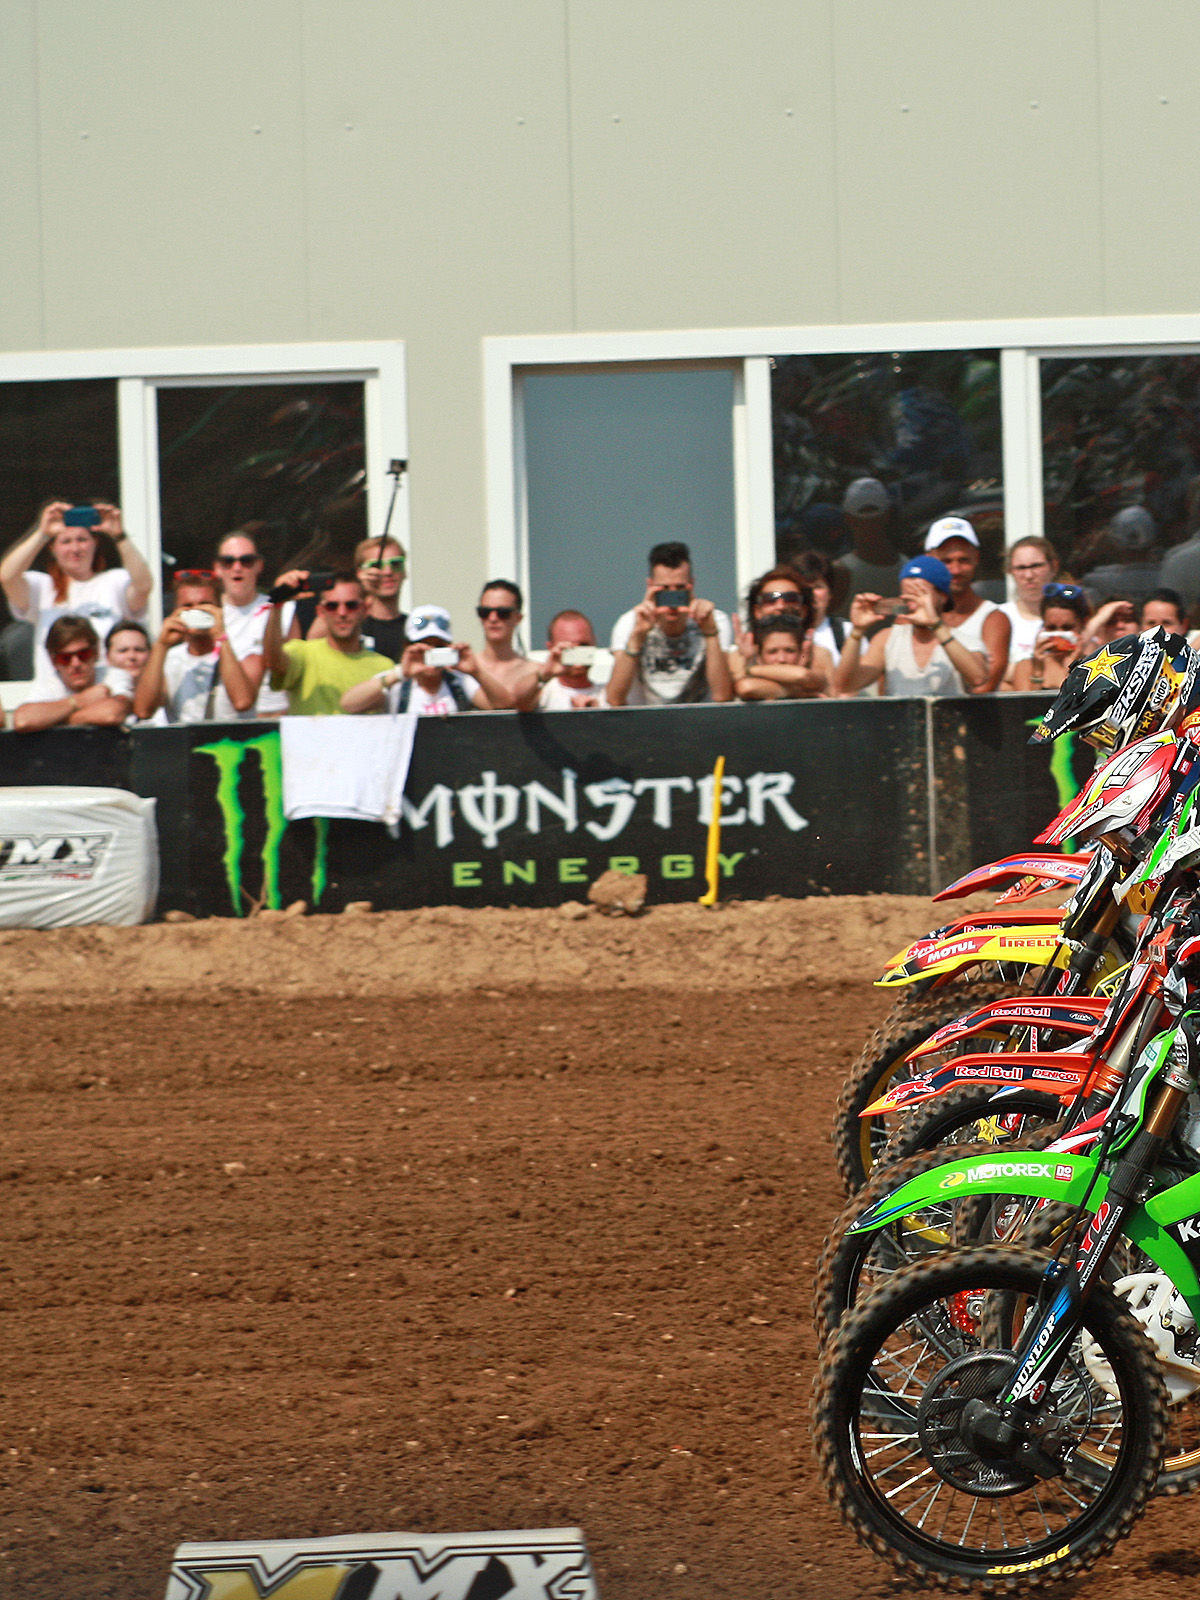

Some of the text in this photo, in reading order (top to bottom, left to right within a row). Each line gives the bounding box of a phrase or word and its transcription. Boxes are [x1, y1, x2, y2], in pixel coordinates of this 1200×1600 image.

[401, 767, 809, 849] MONSTER
[451, 852, 746, 887] ENERGY
[927, 939, 978, 964] MOTUL
[990, 1006, 1051, 1018] Red Bull
[954, 1065, 1024, 1081] Red Bull
[966, 1163, 1052, 1184] MOTOREX
[1010, 1311, 1056, 1404] DUNLOP
[986, 1543, 1071, 1575] DUNLOP
